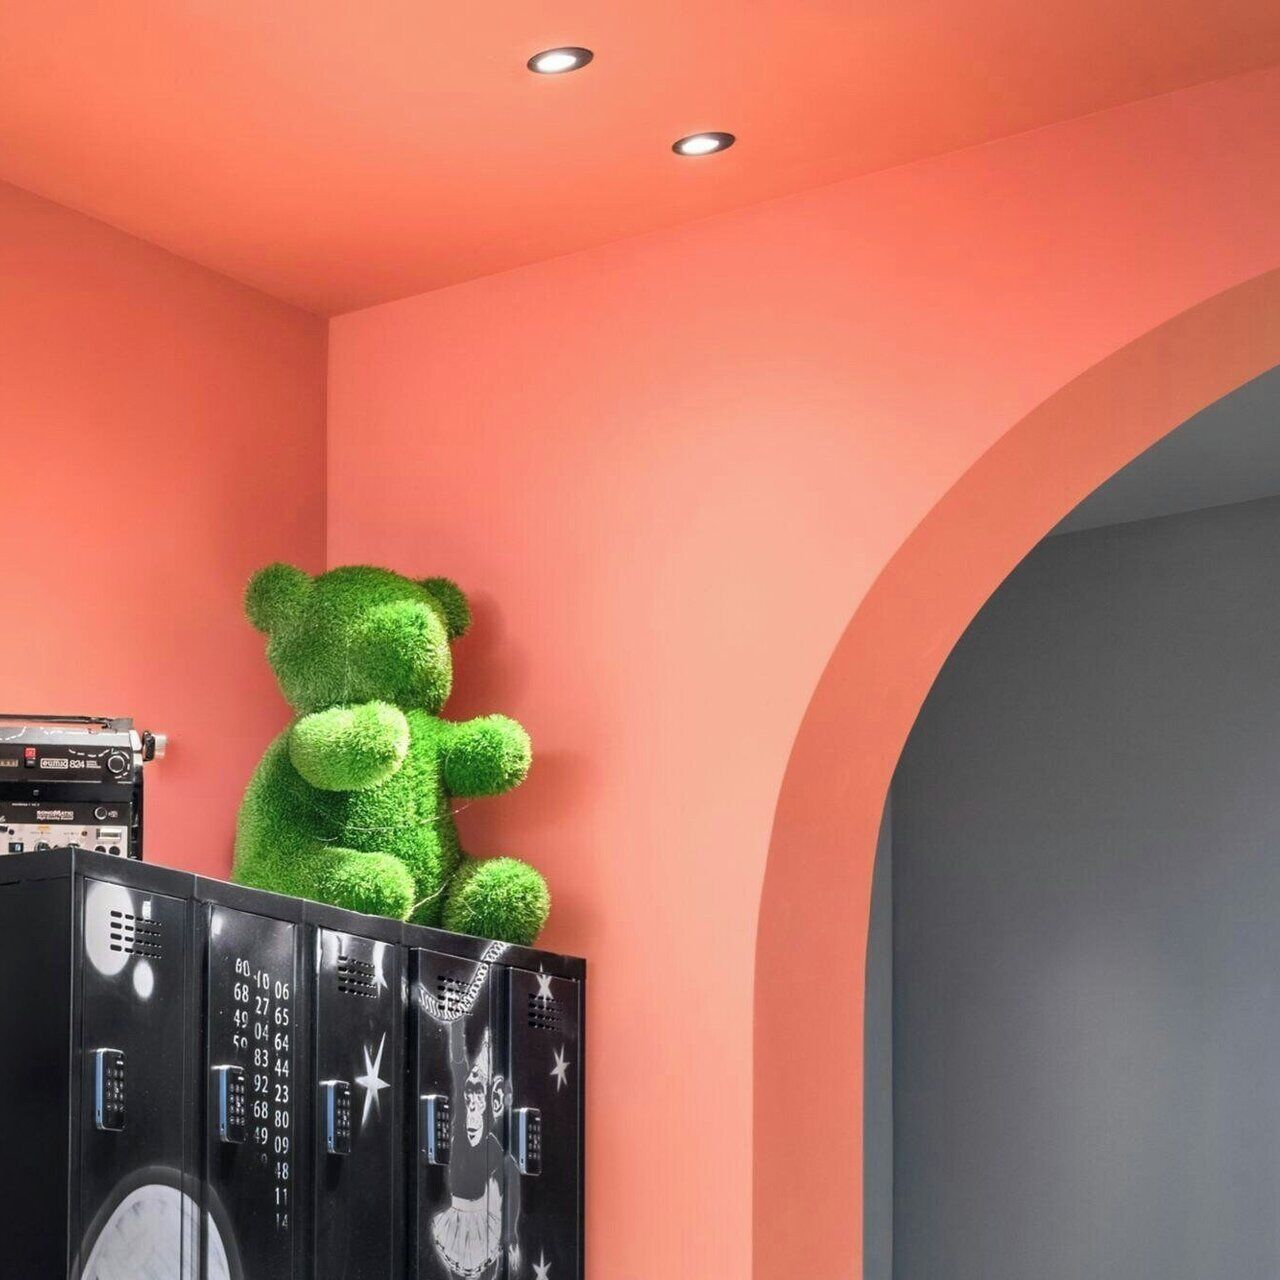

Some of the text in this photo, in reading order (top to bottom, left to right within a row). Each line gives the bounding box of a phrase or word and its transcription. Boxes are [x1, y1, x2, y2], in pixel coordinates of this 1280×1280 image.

[234, 982, 249, 1003] 68
[274, 981, 290, 1000] 06
[255, 996, 270, 1016] 27
[274, 1007, 290, 1026] 65
[254, 1022, 269, 1042] 04
[274, 1033, 290, 1052] 64
[254, 1048, 269, 1068] 83
[274, 1058, 290, 1078] 44
[254, 1074, 269, 1093] 92
[274, 1084, 289, 1103] 23
[253, 1100, 268, 1119] 68
[274, 1110, 290, 1128] 80
[274, 1135, 289, 1154] 09
